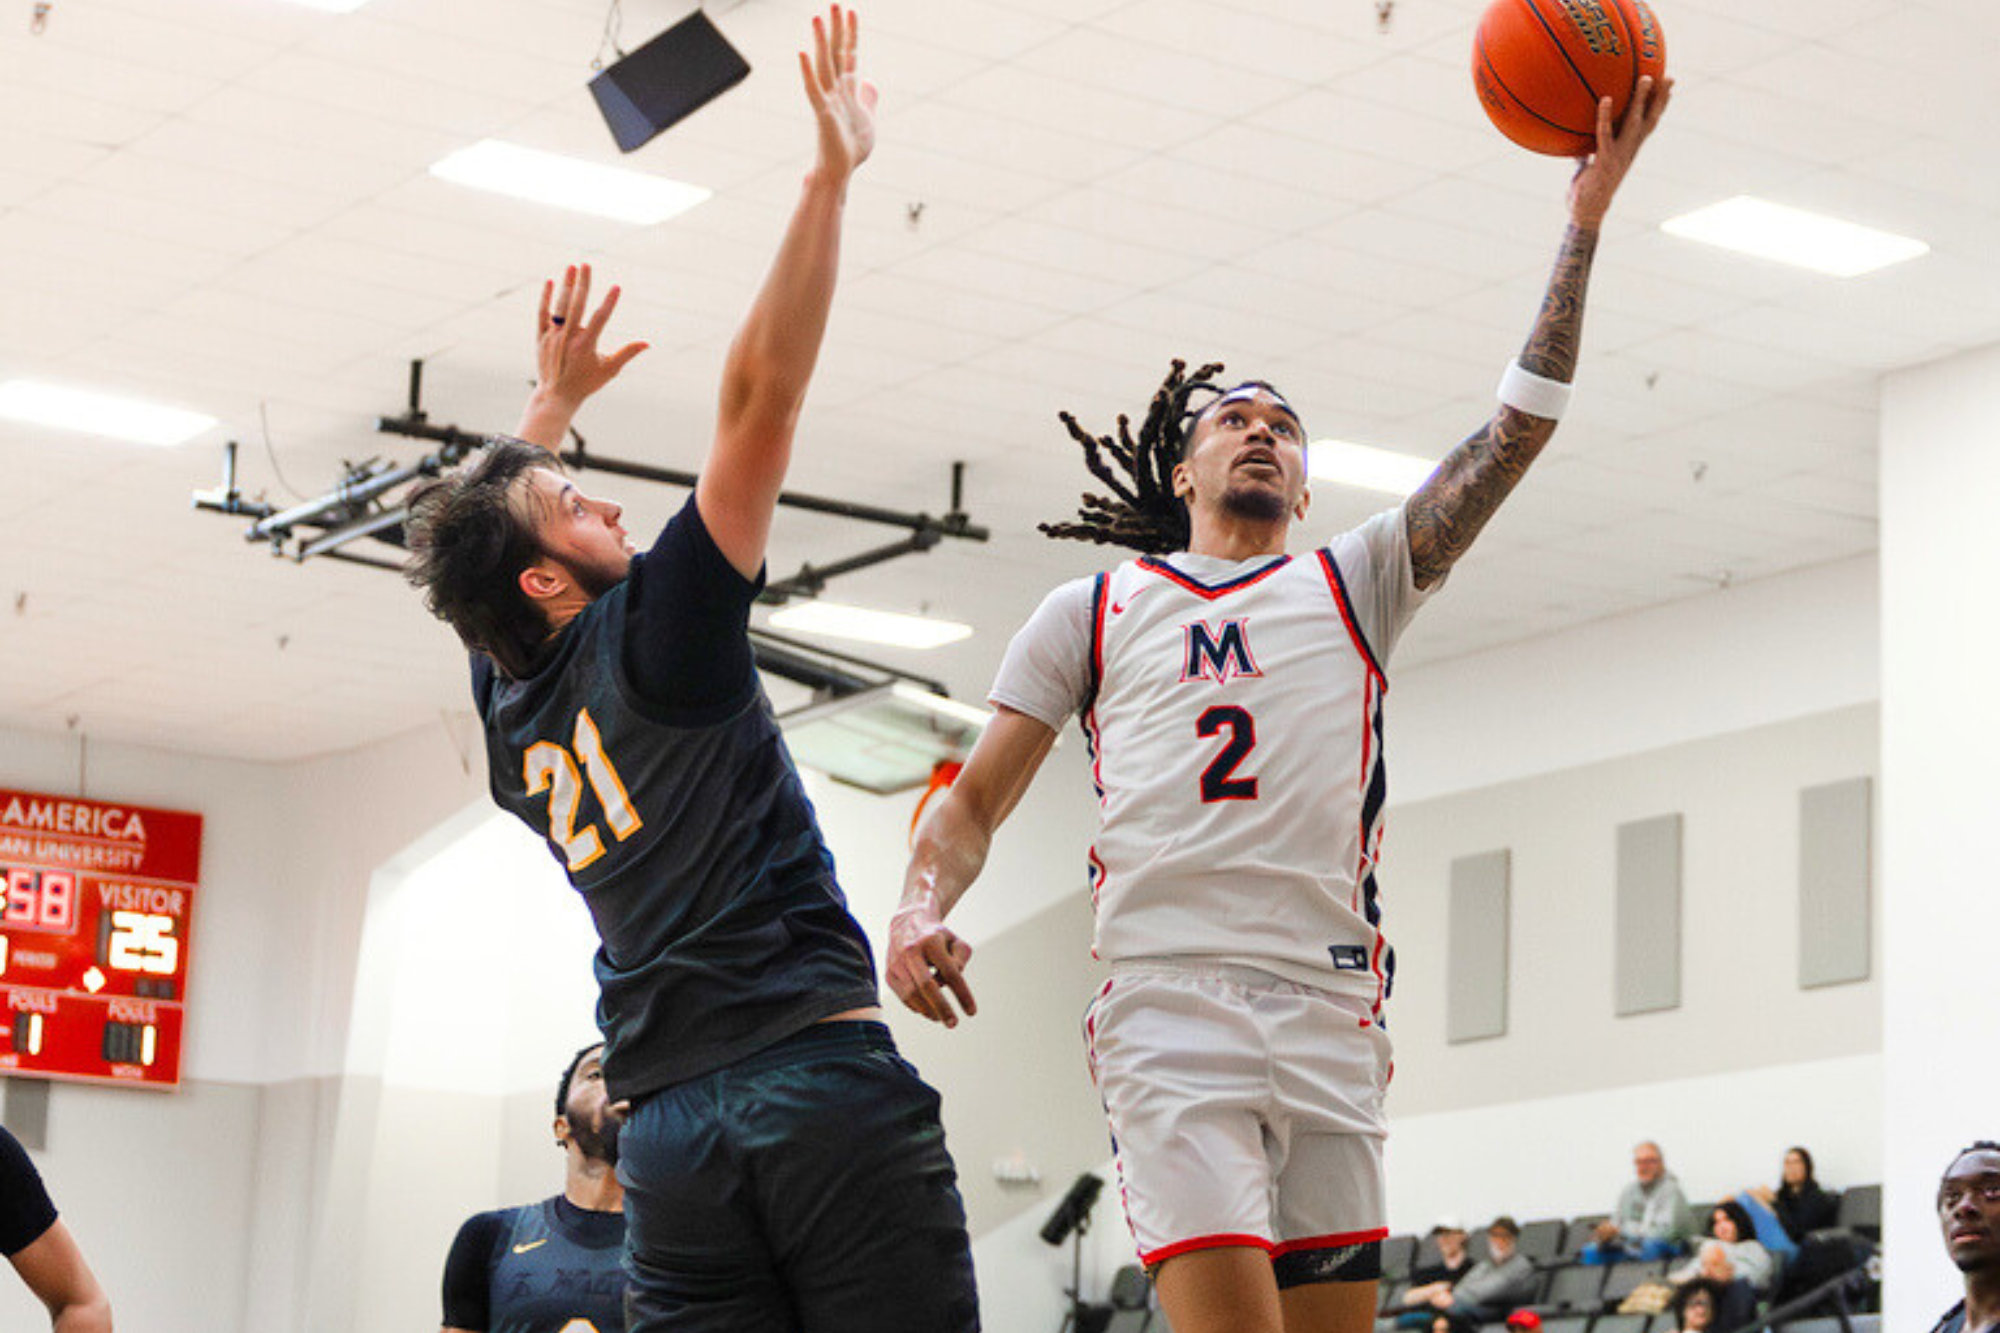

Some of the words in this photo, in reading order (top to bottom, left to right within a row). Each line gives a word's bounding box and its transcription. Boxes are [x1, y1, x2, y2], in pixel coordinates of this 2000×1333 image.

[1179, 617, 1264, 685] M
[1195, 705, 1258, 803] 2
[523, 706, 643, 873] 21
[2, 797, 147, 840] AMERICA
[36, 841, 144, 870] UNIVERSITY
[99, 883, 183, 915] VISITOR
[110, 911, 179, 975] 25
[8, 987, 57, 1014] FOULS
[108, 999, 156, 1024] FOULS
[28, 1012, 43, 1056] 1
[141, 1024, 156, 1066] 1
